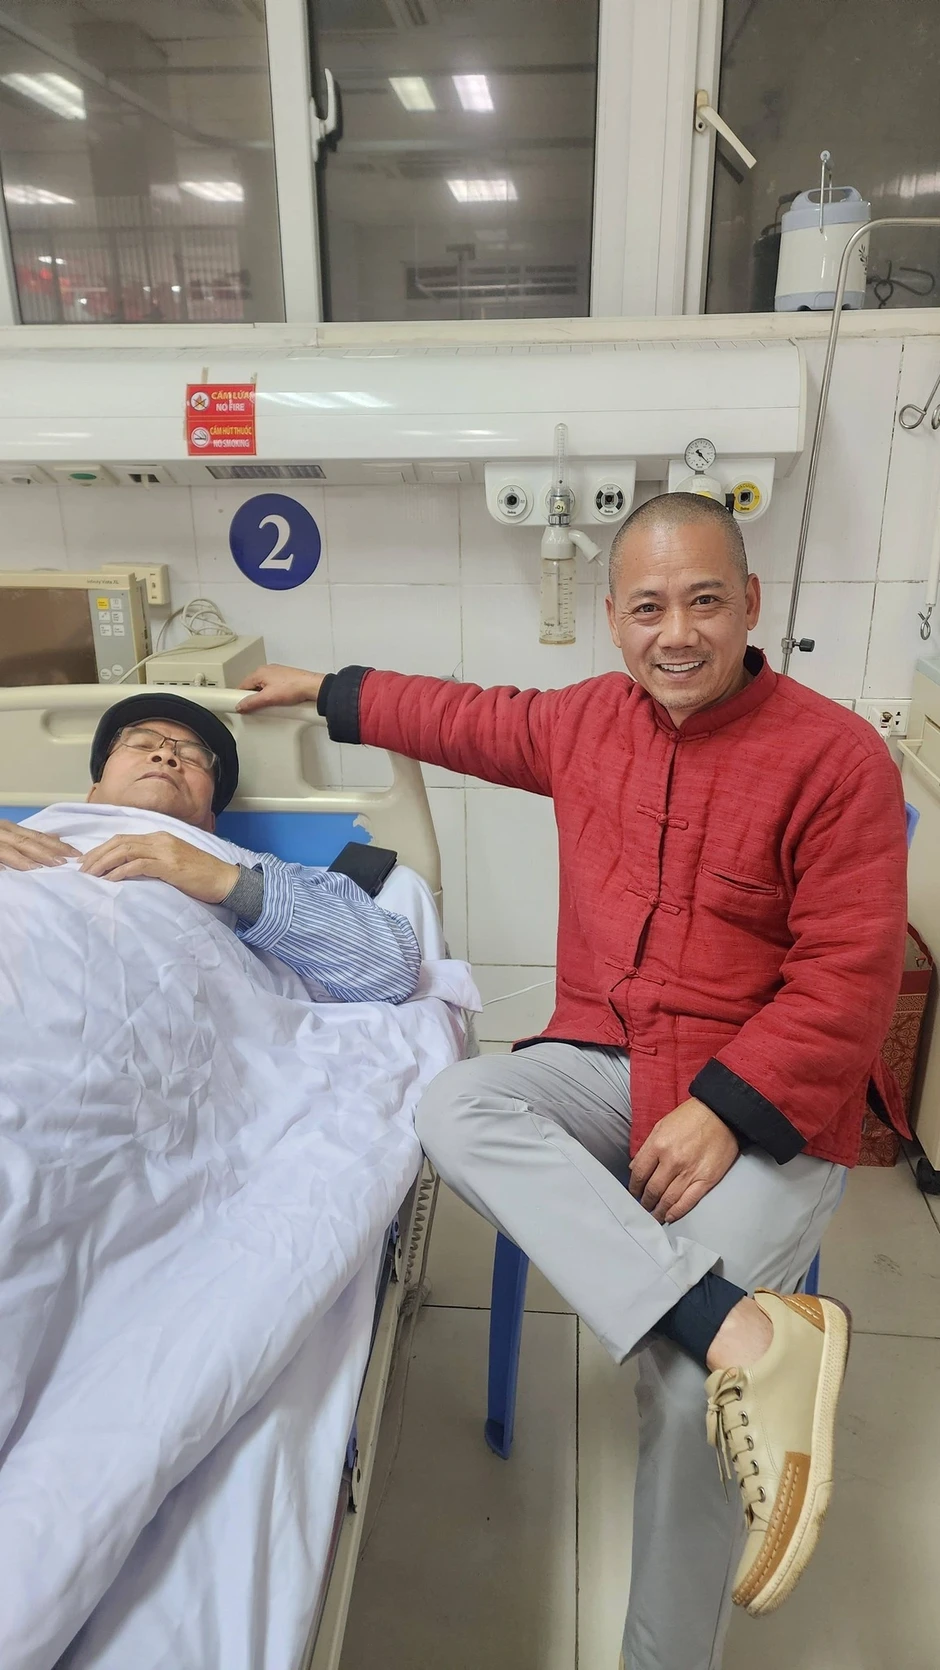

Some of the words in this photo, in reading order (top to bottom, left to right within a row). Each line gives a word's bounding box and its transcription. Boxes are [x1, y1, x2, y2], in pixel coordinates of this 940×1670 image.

[215, 403, 228, 411] NO
[229, 403, 245, 411] FIRE
[213, 439, 223, 447] NO
[223, 439, 250, 447] SMOKING
[259, 514, 294, 571] 2
